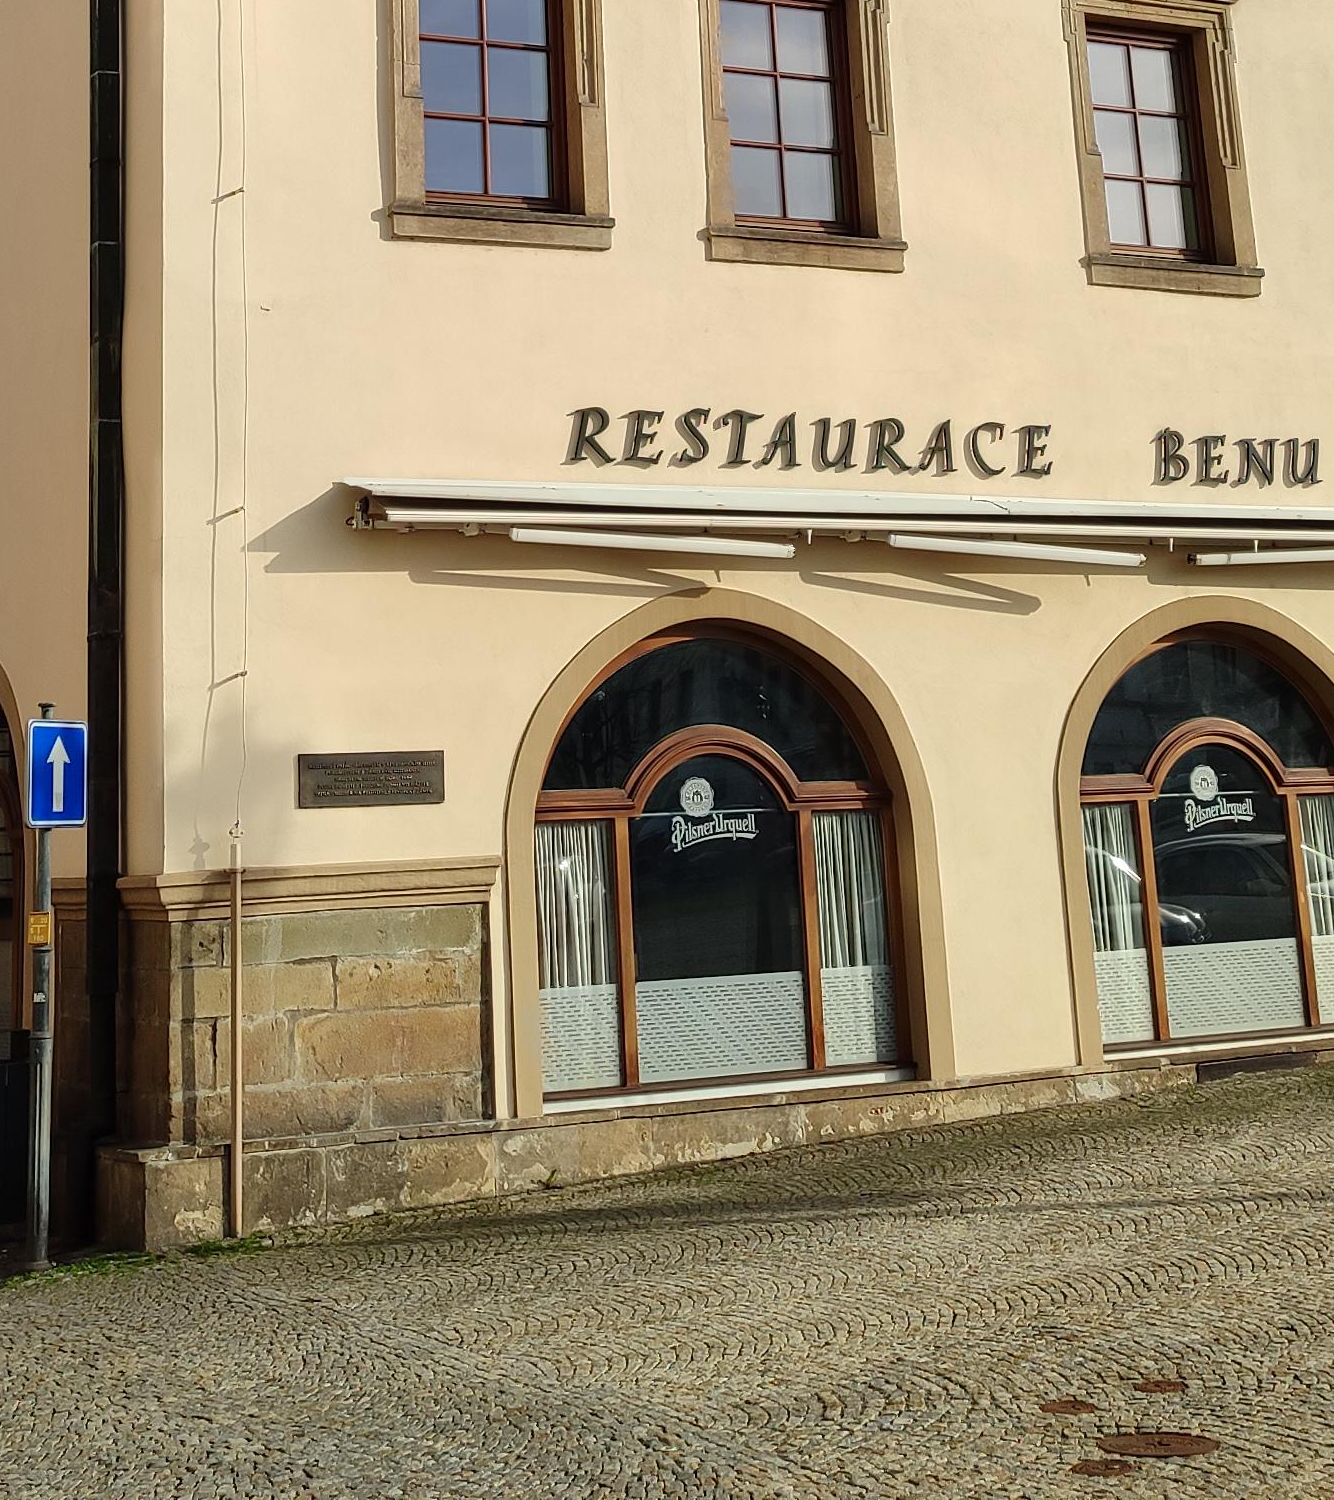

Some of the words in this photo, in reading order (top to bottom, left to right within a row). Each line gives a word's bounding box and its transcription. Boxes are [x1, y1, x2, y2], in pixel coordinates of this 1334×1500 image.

[561, 406, 1053, 477] RESTAURACE
[1150, 427, 1323, 488] BENU
[671, 816, 715, 852] Pilsner
[713, 813, 756, 841] Urquell
[1184, 799, 1221, 832] Pilsner
[1217, 796, 1254, 823] Urquell
